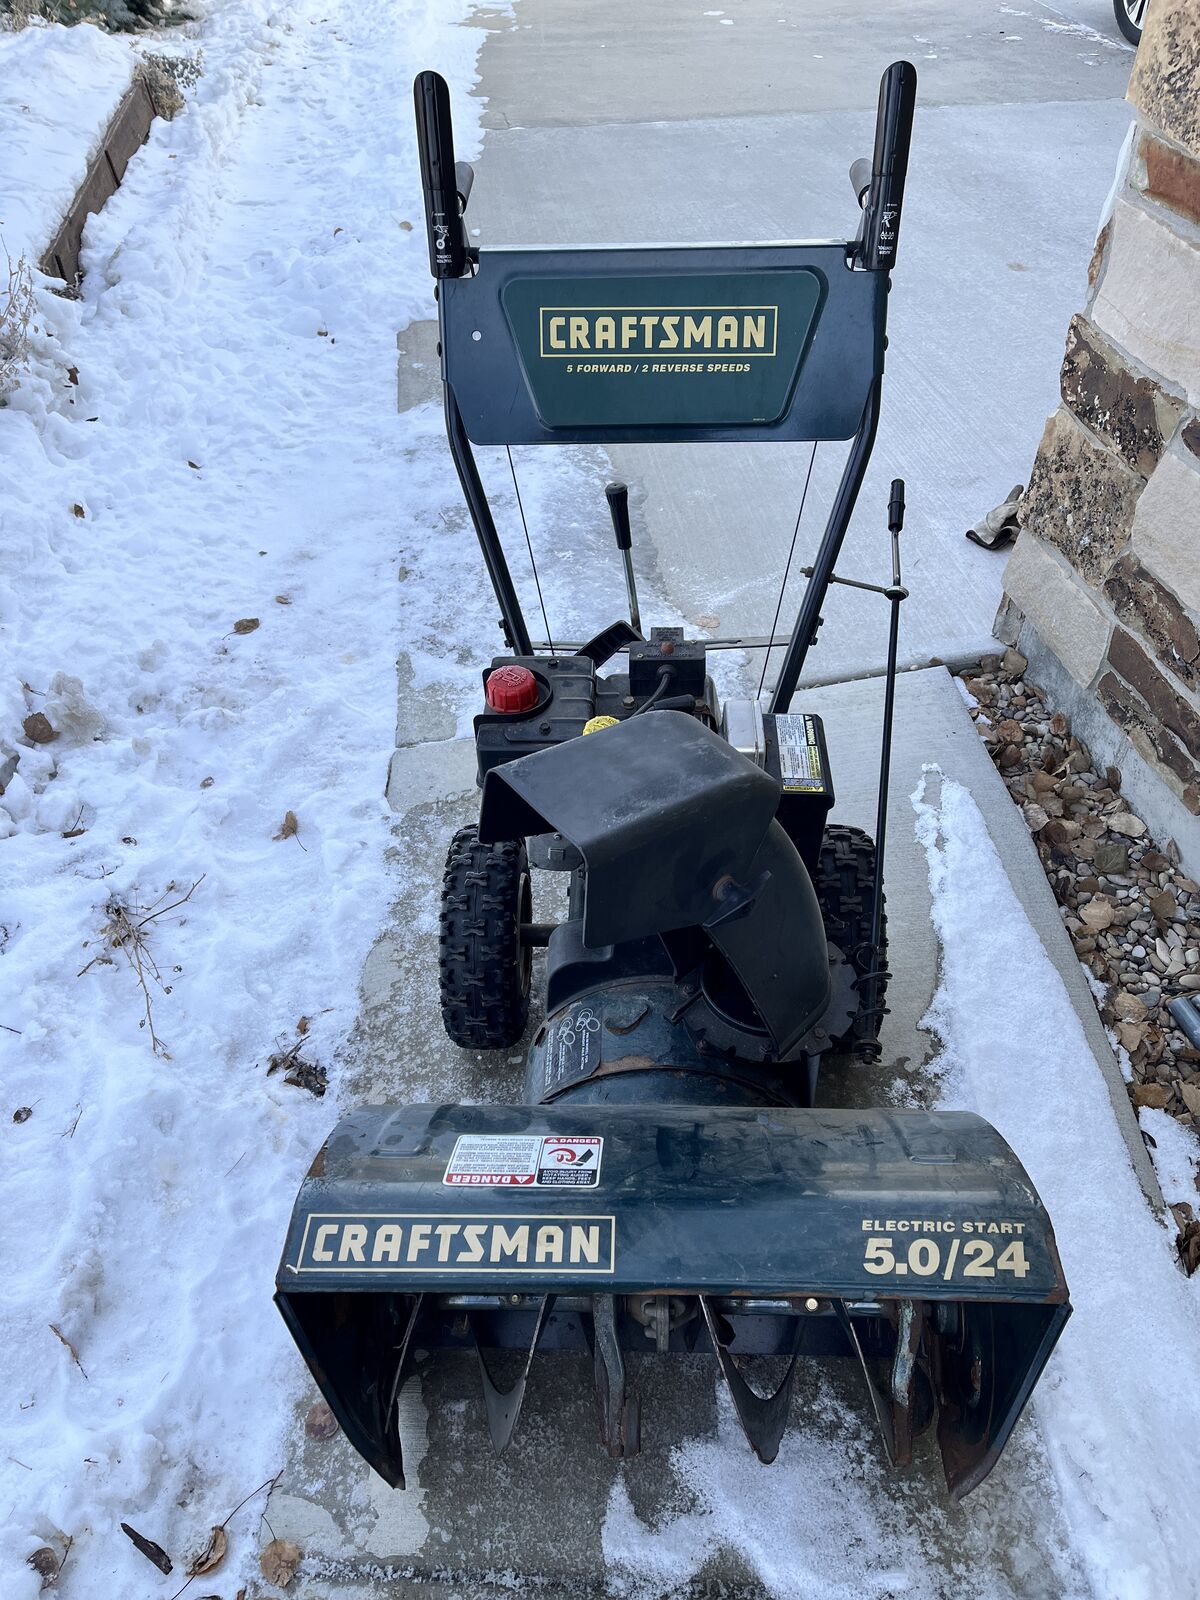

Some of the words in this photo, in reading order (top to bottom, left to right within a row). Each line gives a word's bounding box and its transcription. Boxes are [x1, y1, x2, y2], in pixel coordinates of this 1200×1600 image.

[549, 315, 766, 349] CRAFTSMAN
[566, 364, 573, 373] 5
[577, 364, 633, 373] FORWARD
[641, 364, 649, 373] 2
[652, 364, 704, 373] REVERSE
[707, 363, 751, 373] SPEEDS
[451, 1175, 512, 1183] DANGER
[862, 1220, 956, 1232] ELECTRIC
[962, 1222, 1026, 1234] START
[312, 1224, 600, 1263] CRAFTSMAN
[863, 1237, 1030, 1281] 5.0/24
